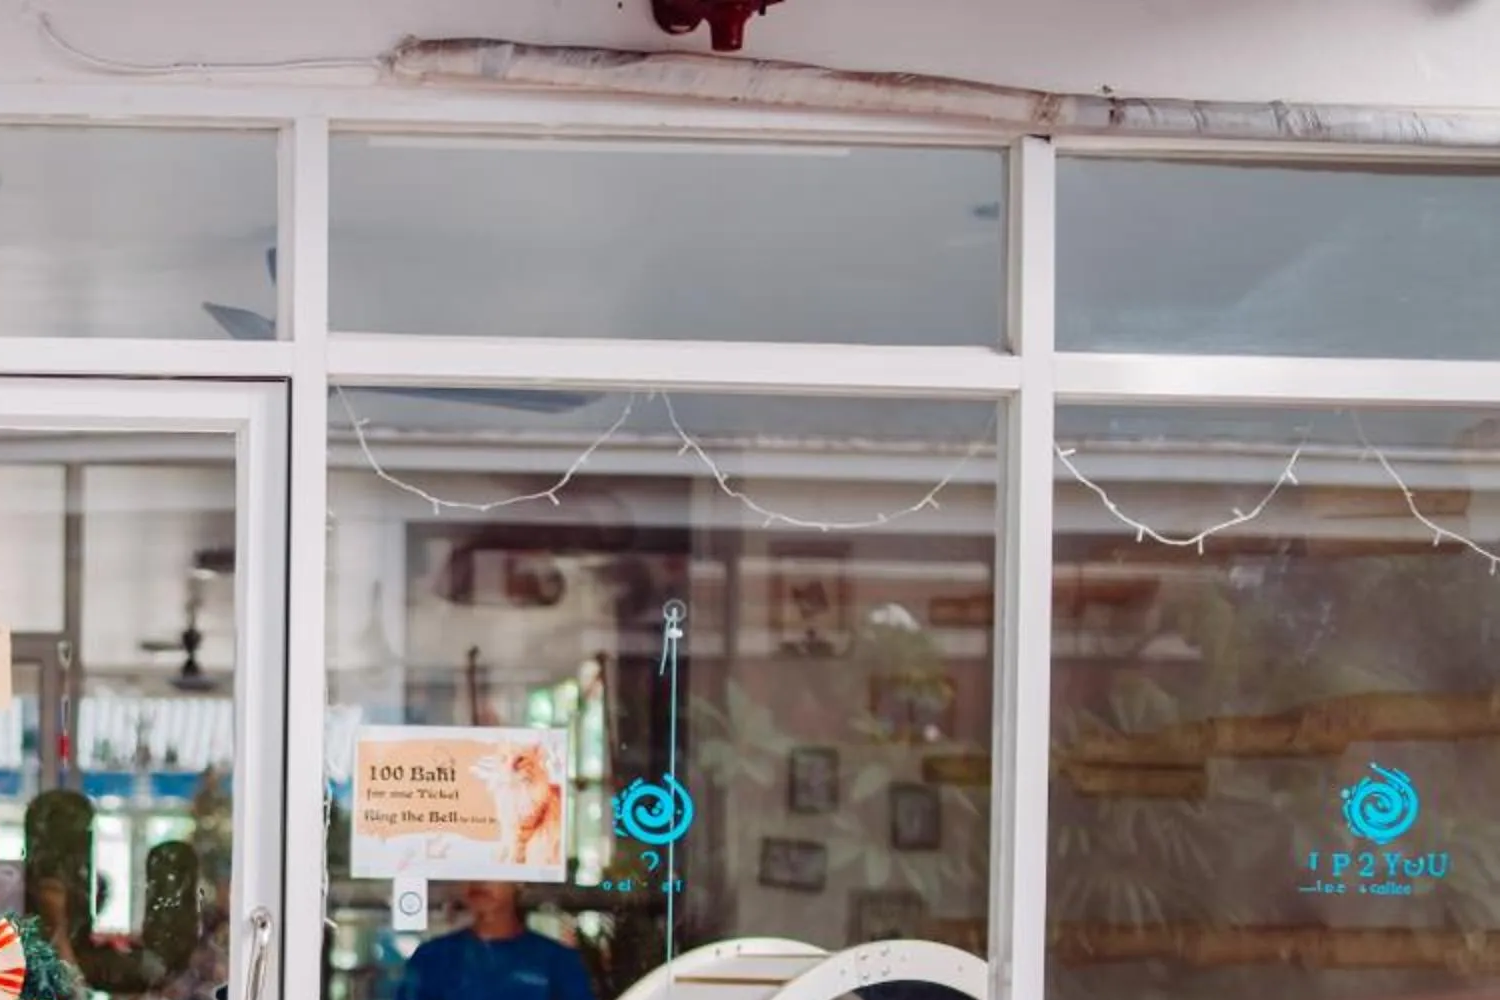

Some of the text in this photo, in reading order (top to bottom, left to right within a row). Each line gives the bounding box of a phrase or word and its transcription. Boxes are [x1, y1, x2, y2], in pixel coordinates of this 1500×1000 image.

[369, 765, 457, 782] 100 Baht
[401, 809, 425, 822] the
[428, 810, 458, 823] Bell
